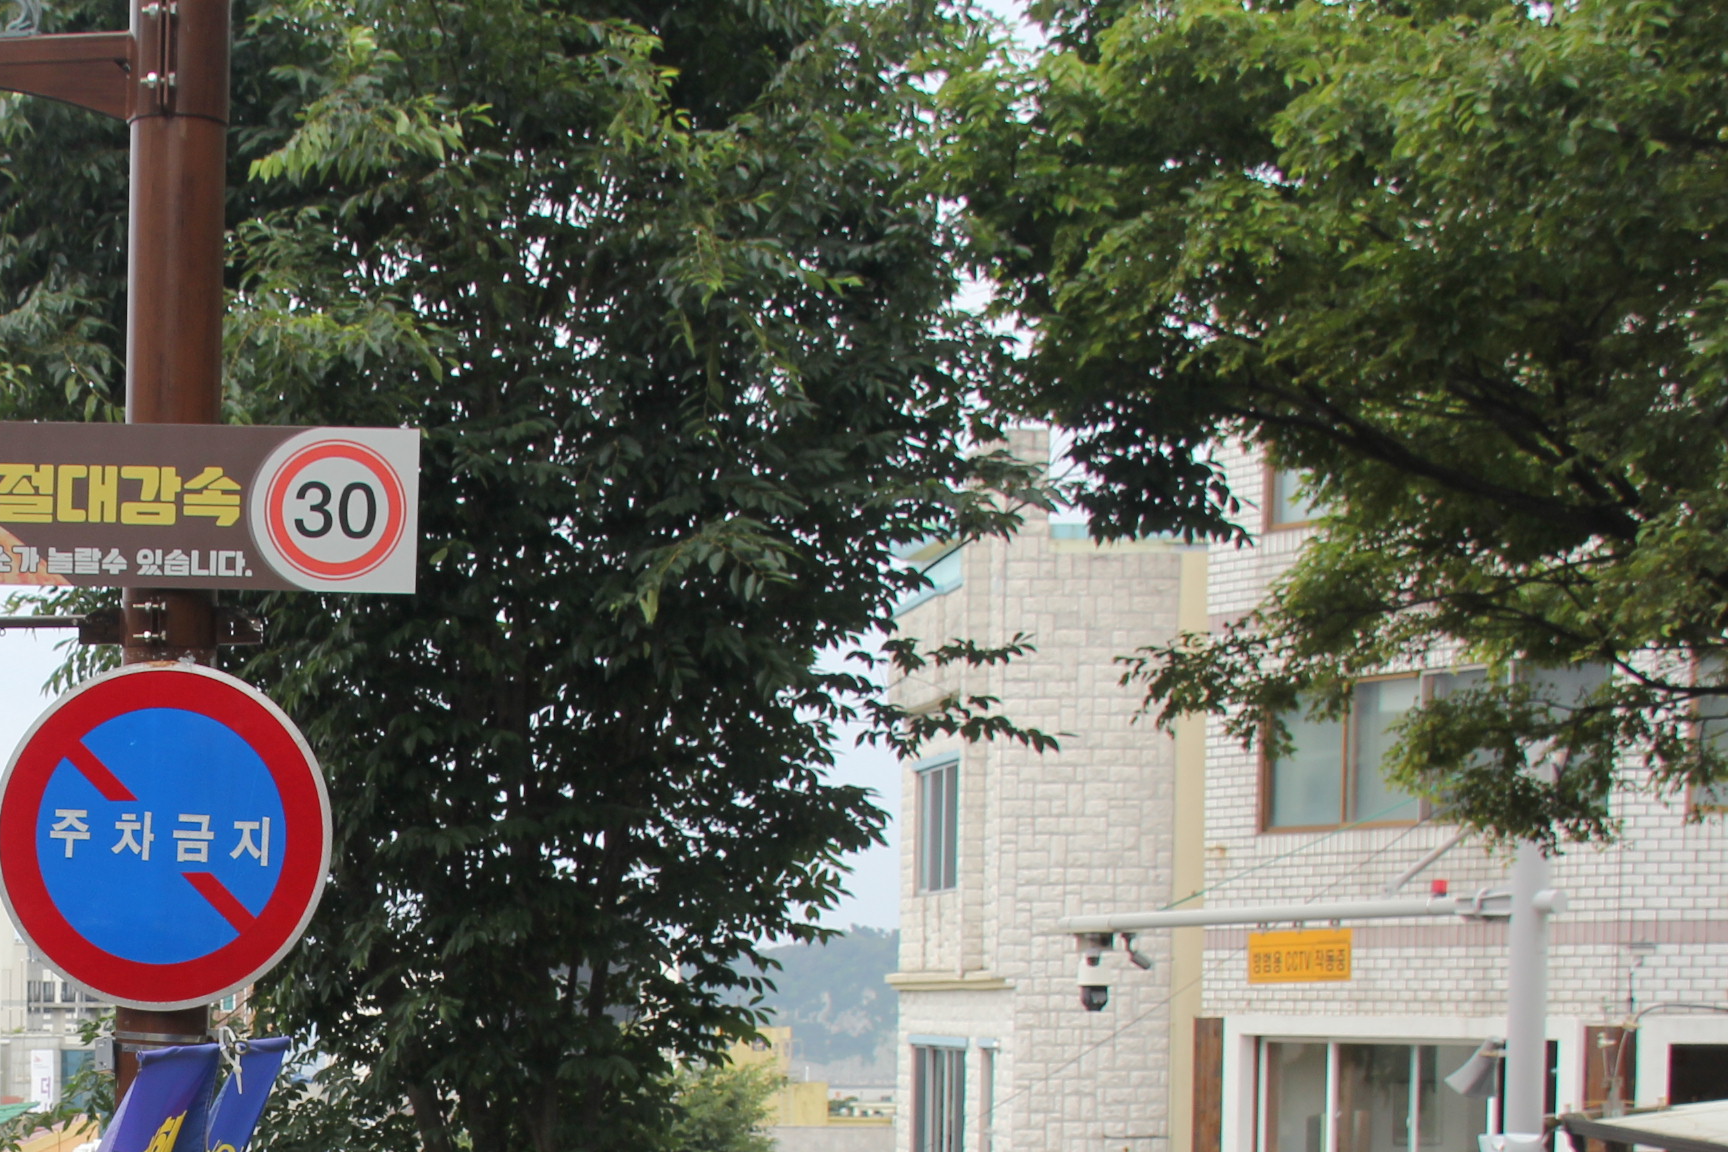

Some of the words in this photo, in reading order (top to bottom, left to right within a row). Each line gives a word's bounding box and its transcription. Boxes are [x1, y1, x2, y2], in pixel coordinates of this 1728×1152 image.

[293, 481, 378, 539] 30
[47, 547, 128, 576] 놀랄수
[136, 549, 253, 577] 있습니다.
[48, 807, 272, 867] 주차금지
[1285, 950, 1310, 972] CCTV
